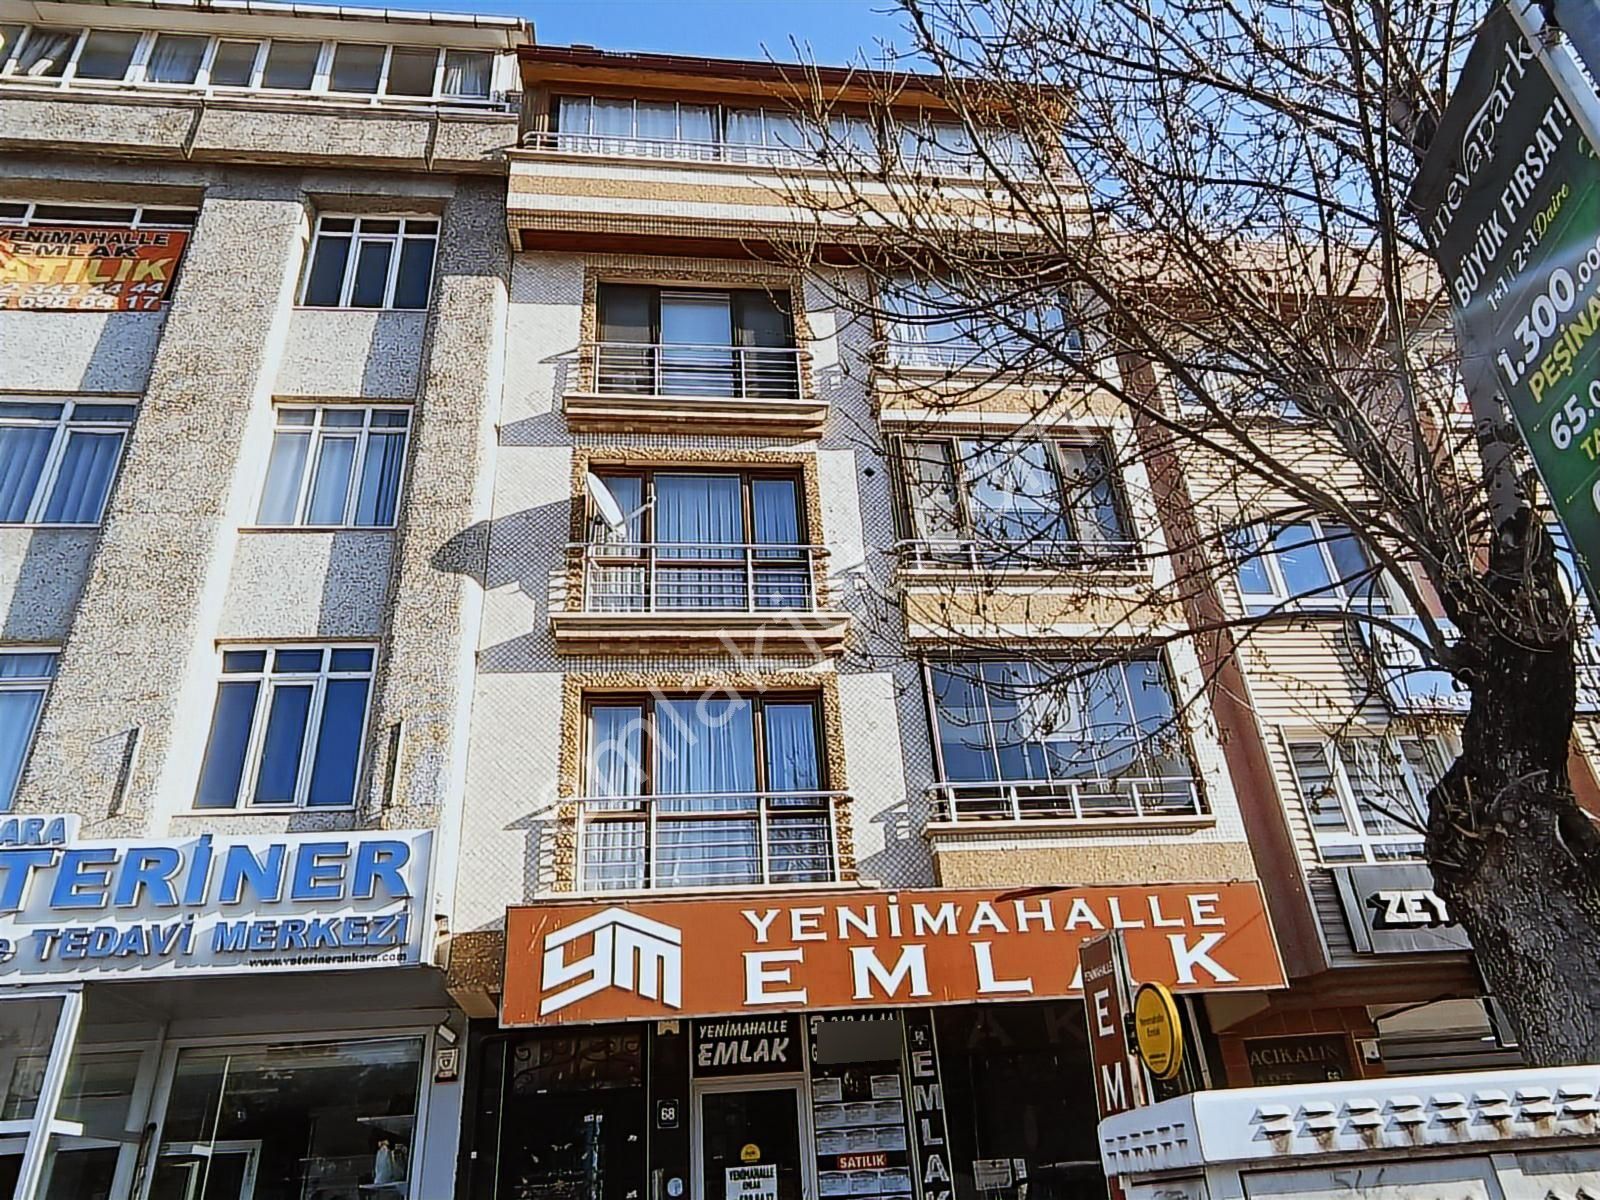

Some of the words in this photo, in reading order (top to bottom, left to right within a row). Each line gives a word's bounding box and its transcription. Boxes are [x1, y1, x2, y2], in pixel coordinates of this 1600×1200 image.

[1454, 208, 1508, 308] BÜYÜK
[1501, 96, 1572, 224] FIRSAT!
[12, 243, 139, 258] EMLAK
[91, 283, 122, 294] 44
[130, 282, 164, 293] 44
[126, 295, 158, 309] 17
[1487, 276, 1509, 311] 1+1
[1528, 284, 1600, 403] PEŞİNA
[0, 833, 413, 914] TERİNER
[32, 913, 197, 962] TEDAVİ
[212, 904, 411, 954] MERKEZİ
[740, 892, 1226, 944] YENİMAHALLE
[699, 1019, 788, 1039] YENİMAHALLE
[697, 1037, 789, 1067] EMLAK
[661, 1106, 675, 1121] 68
[839, 1154, 887, 1170] SATILIK
